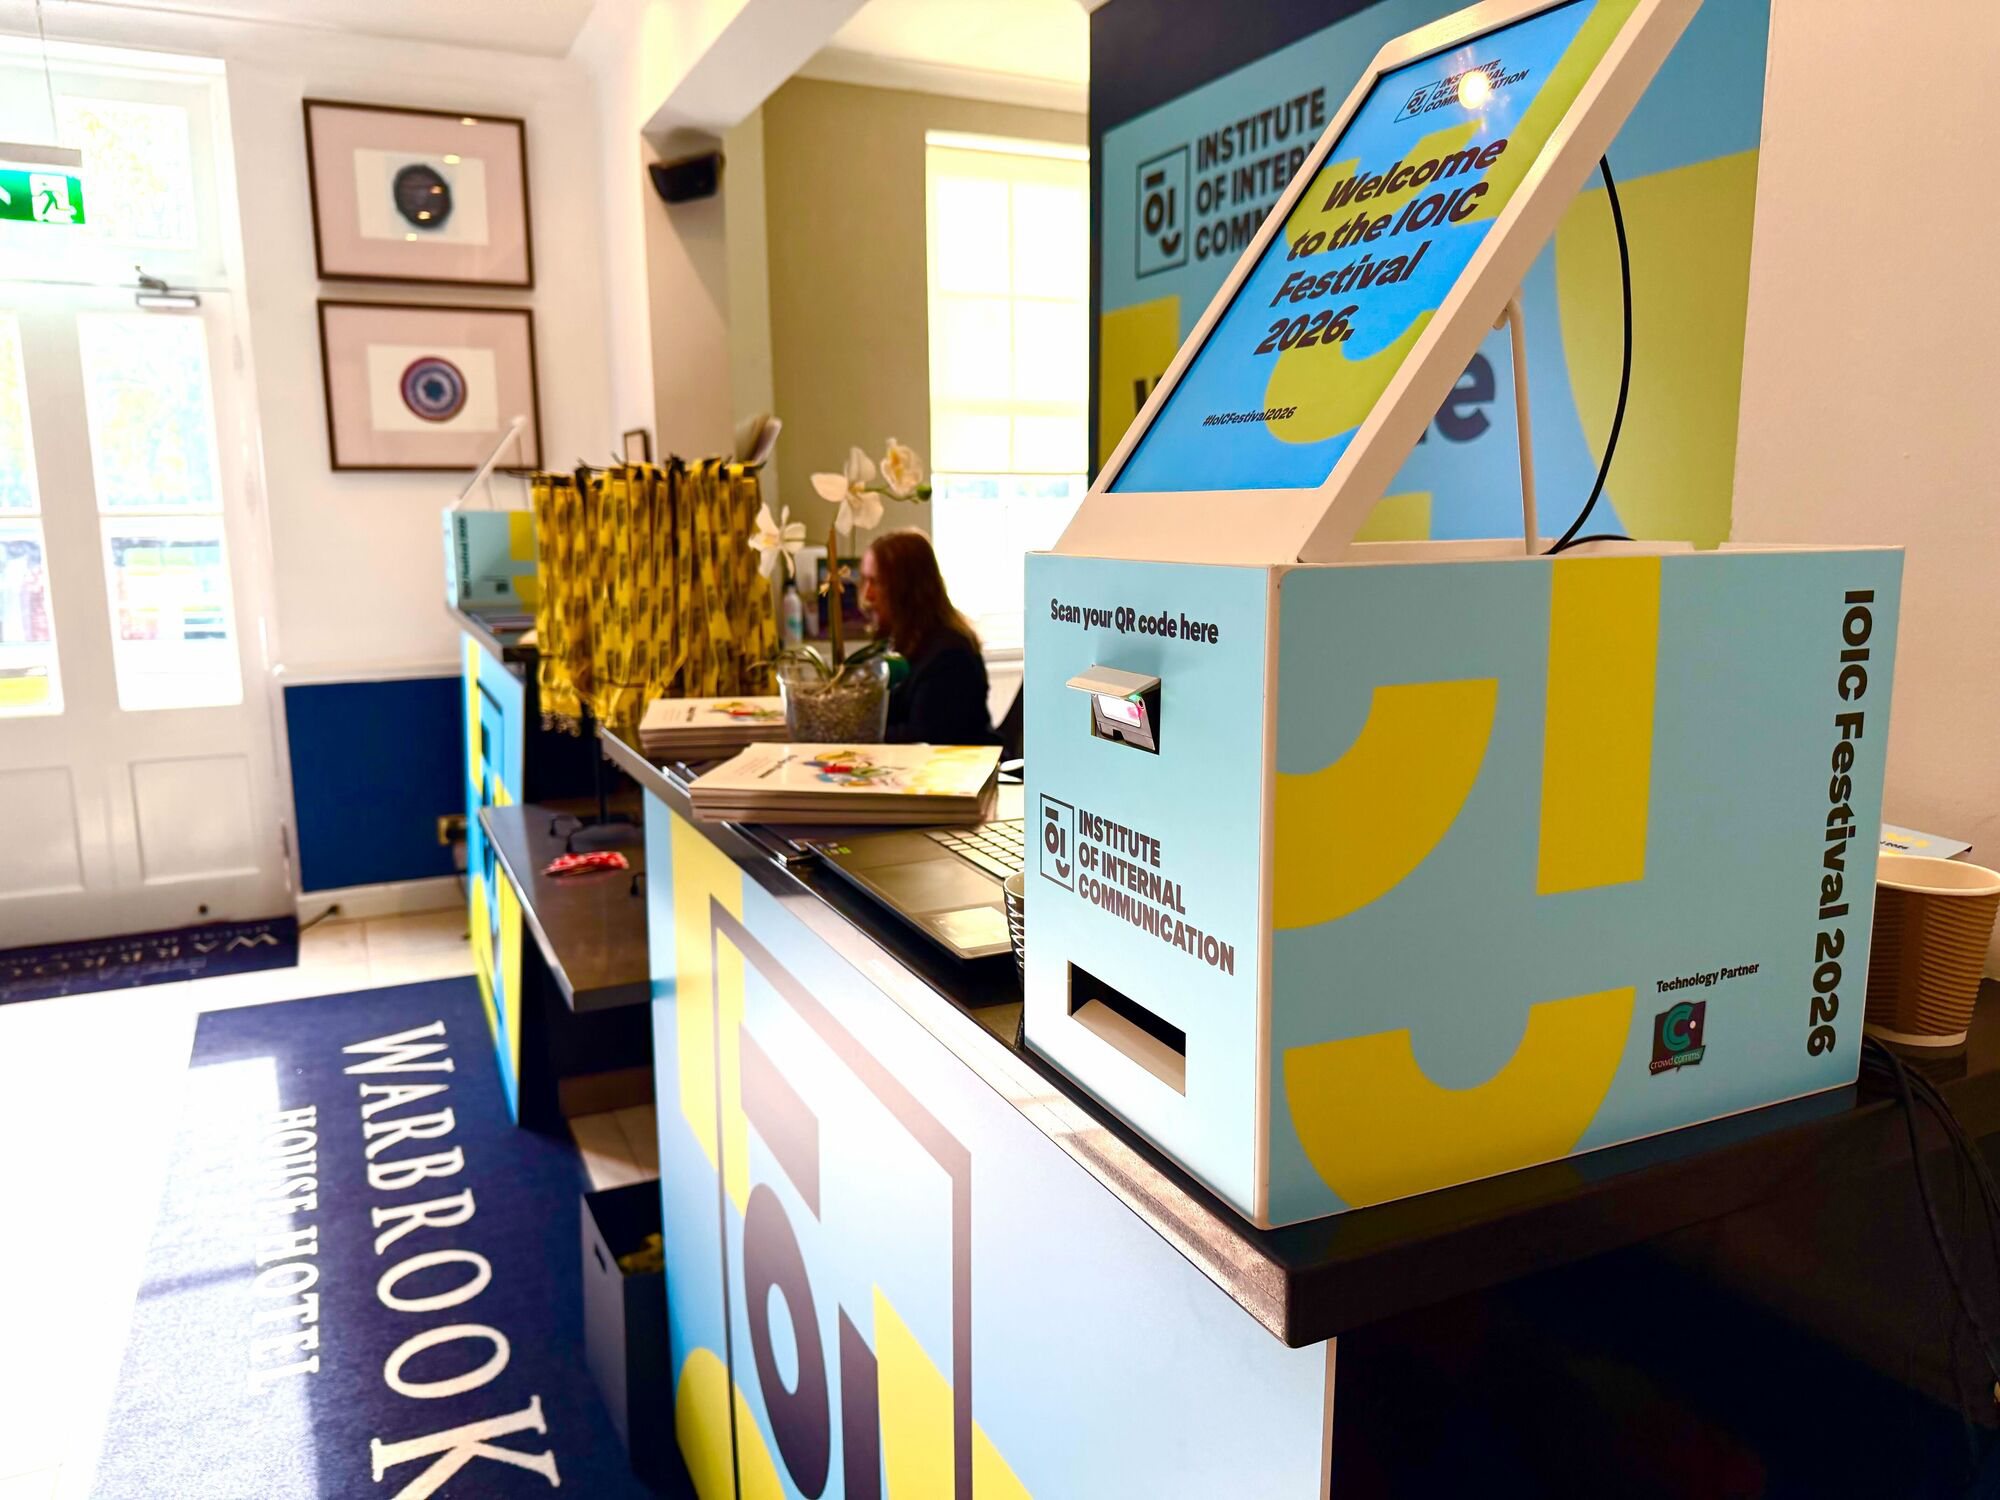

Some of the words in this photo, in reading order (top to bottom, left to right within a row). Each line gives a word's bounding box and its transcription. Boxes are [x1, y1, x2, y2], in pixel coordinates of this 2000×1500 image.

[1197, 87, 1325, 173] INSTITUTE
[1432, 86, 1449, 100] OF
[1196, 175, 1226, 216] OF
[1231, 140, 1317, 206] INTER
[1321, 139, 1508, 213] Welcome
[1286, 228, 1327, 262] to
[1327, 211, 1392, 251] the
[1389, 182, 1489, 237] IOIC
[1269, 240, 1432, 308] Festival
[1253, 305, 1359, 356] 2026.
[1202, 406, 1298, 428] #IoICFestival2026
[1050, 598, 1081, 624] Scan
[1083, 607, 1113, 631] your
[1115, 606, 1136, 634] QR
[1138, 611, 1177, 638] code
[1180, 613, 1219, 645] here
[1837, 590, 1875, 701] IOIC
[1079, 809, 1161, 868] INSTITUTE
[1819, 711, 1865, 920] Festival
[1079, 841, 1099, 872] OF
[1102, 851, 1186, 915] INTERNAL
[1079, 873, 1235, 976] COMMUNICATION
[1656, 972, 1719, 993] Technology
[1720, 963, 1760, 980] Partner
[1806, 928, 1845, 1057] 2026
[264, 1105, 318, 1218] HOUSE
[342, 1020, 561, 1500] WARBROOK
